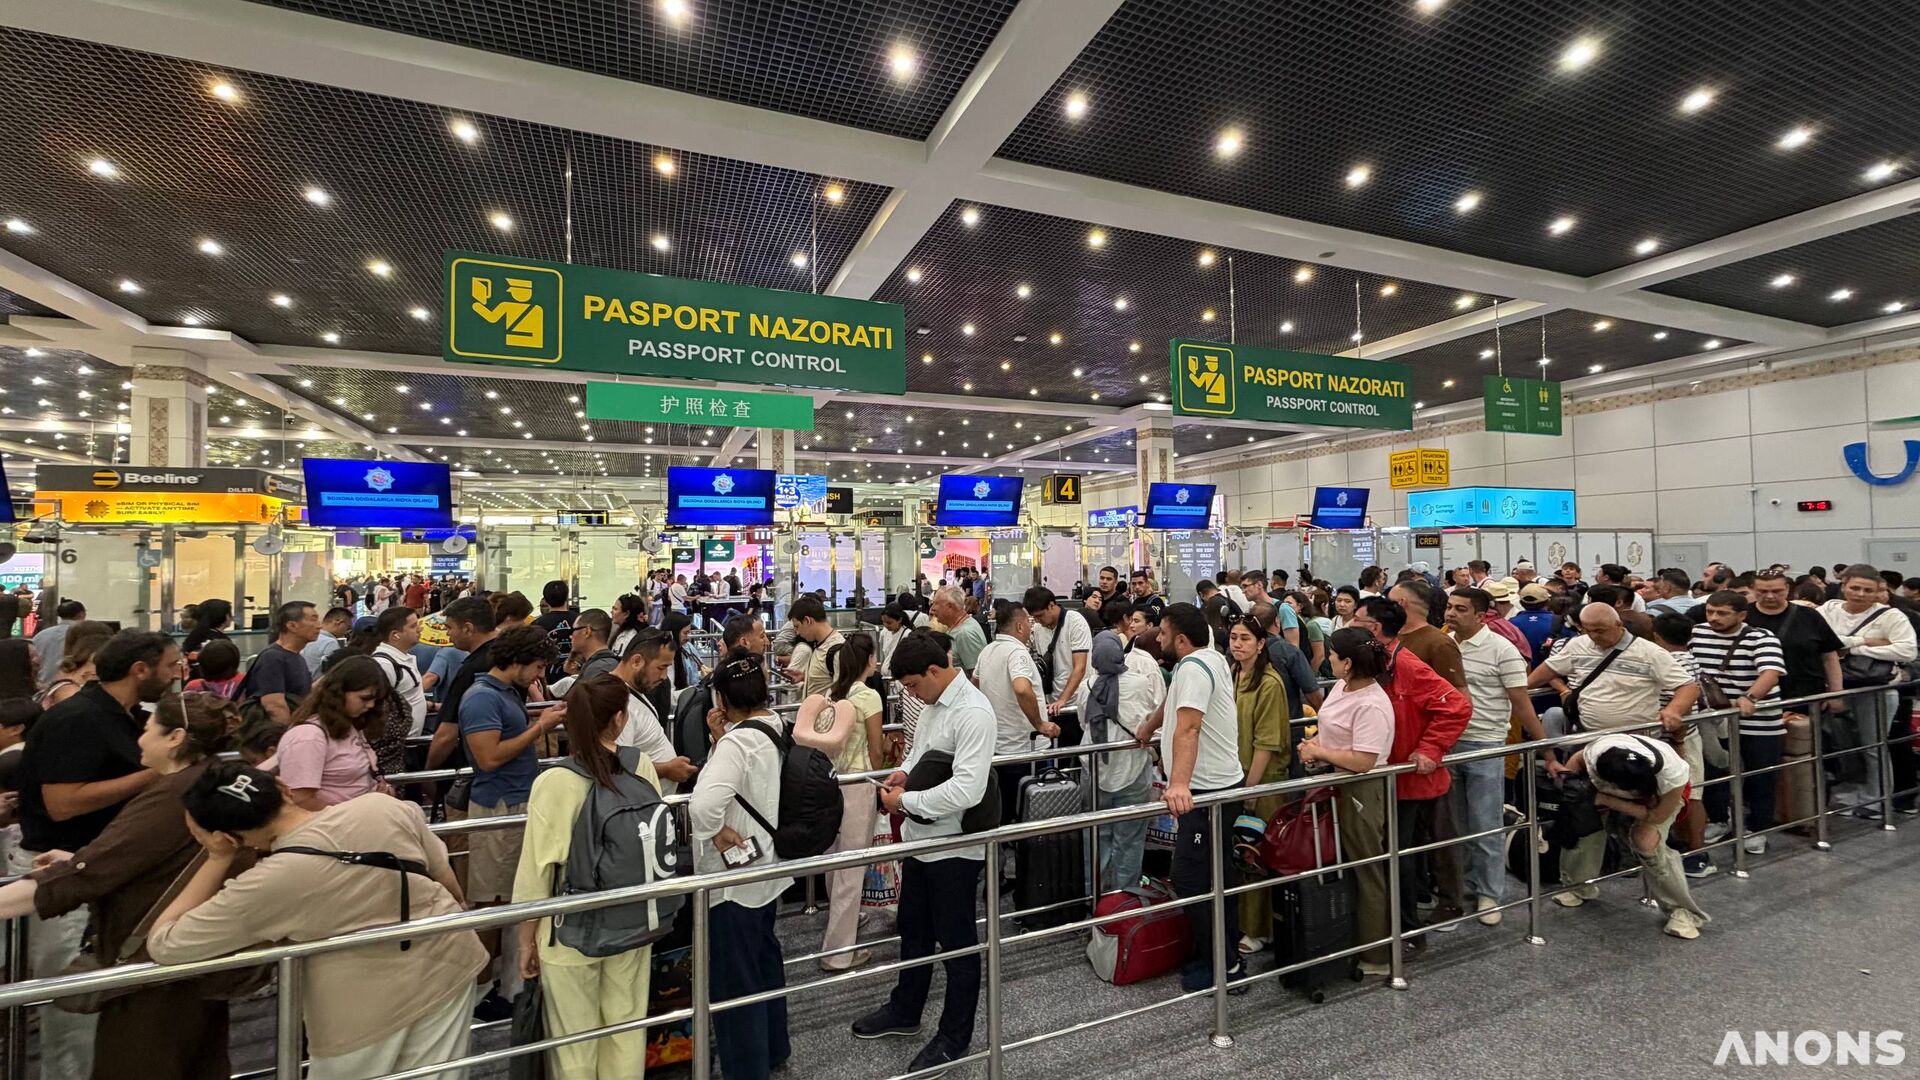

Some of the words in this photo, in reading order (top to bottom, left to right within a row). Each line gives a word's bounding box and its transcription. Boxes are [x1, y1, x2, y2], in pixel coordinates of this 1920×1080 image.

[584, 294, 741, 335] PASPORT
[749, 314, 893, 350] NAZORATI
[628, 339, 745, 366] PASSPORT
[750, 351, 846, 374] CONTROL
[1243, 365, 1324, 391] PASPORT
[1328, 375, 1405, 398] NAZORATI
[660, 395, 752, 419] 护照检查
[1266, 396, 1328, 412] PASSPORT
[1329, 401, 1381, 417] CONTROL
[124, 473, 200, 485] Beeline
[1060, 478, 1075, 500] 4
[801, 545, 810, 556] 8
[1226, 542, 1236, 552] 10
[1420, 537, 1439, 545] CREW
[61, 548, 78, 564] 6
